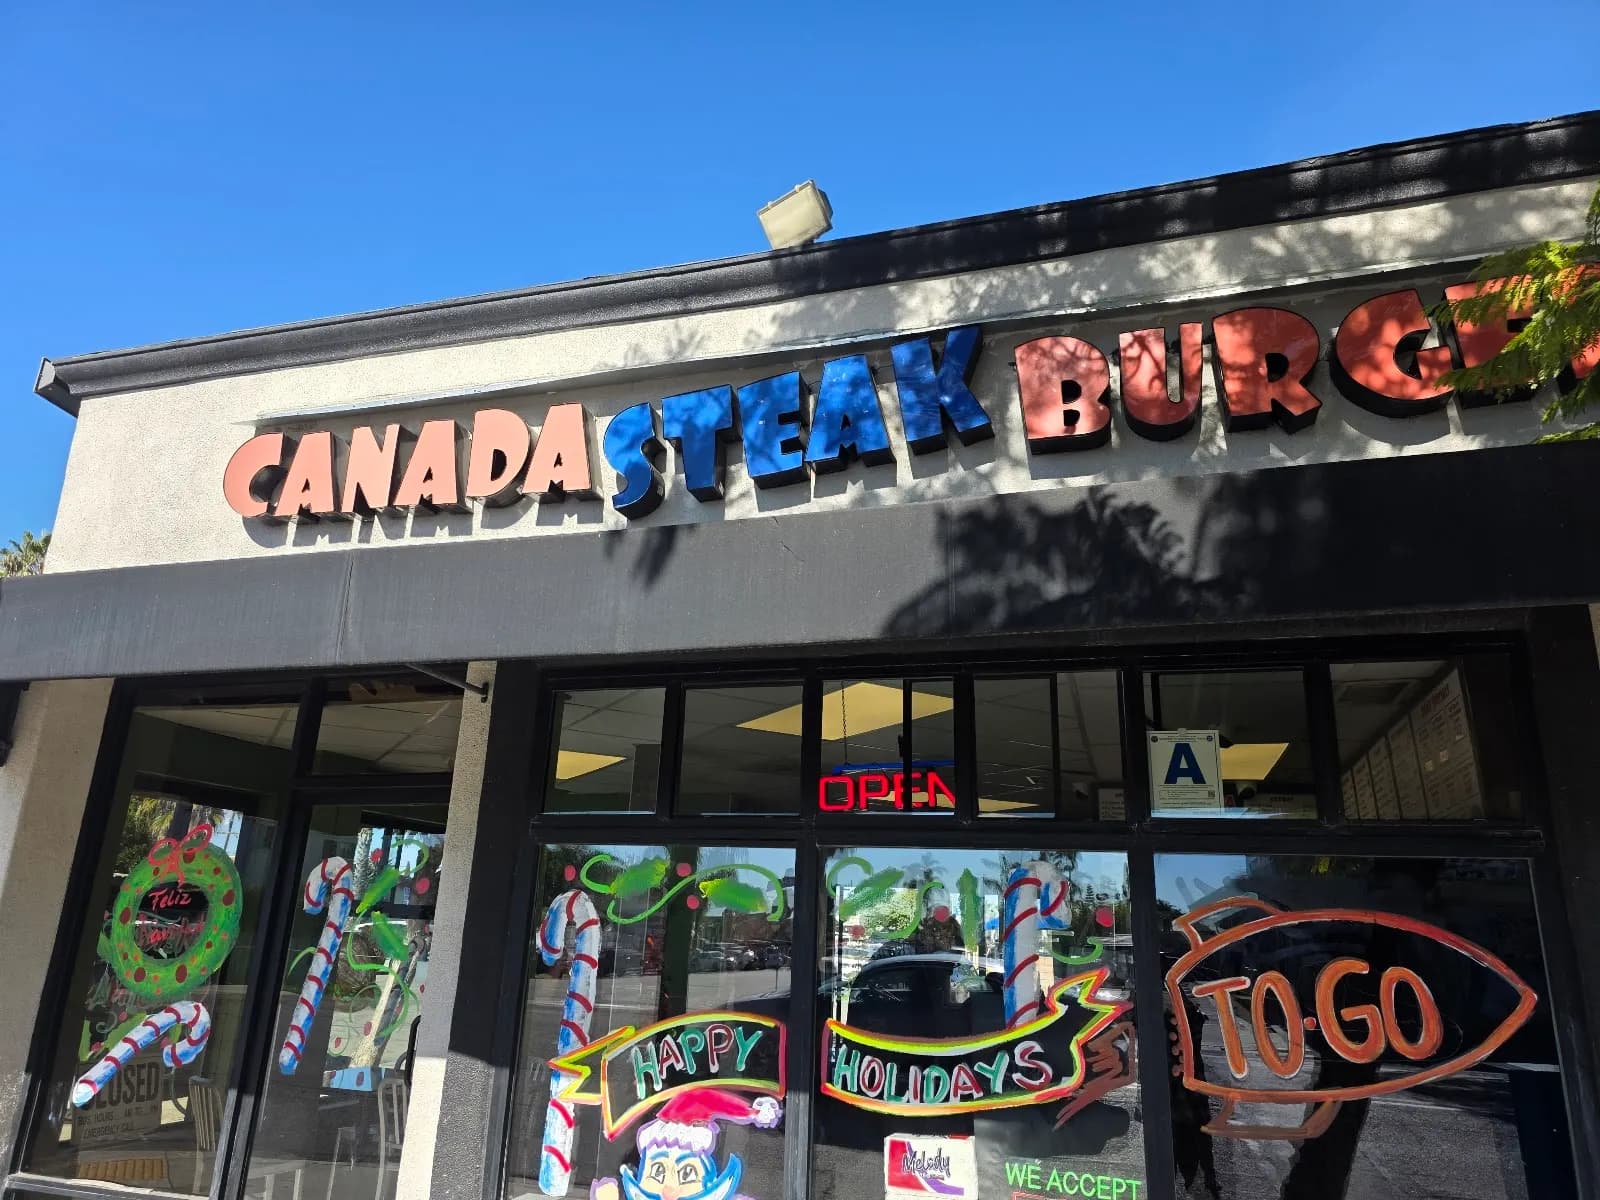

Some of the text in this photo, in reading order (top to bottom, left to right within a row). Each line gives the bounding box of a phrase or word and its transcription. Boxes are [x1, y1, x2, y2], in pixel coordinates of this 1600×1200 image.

[223, 403, 602, 519] CANADA
[603, 327, 993, 520] STEAK
[1164, 743, 1206, 784] A
[819, 772, 956, 811] OPEN
[148, 888, 192, 911] Feliz
[632, 1023, 1053, 1104] HAPPY HOLIDAYS
[81, 1061, 160, 1111] LOSED
[902, 1147, 951, 1178] Melody
[1005, 1162, 1141, 1200] WE ACCEPT
